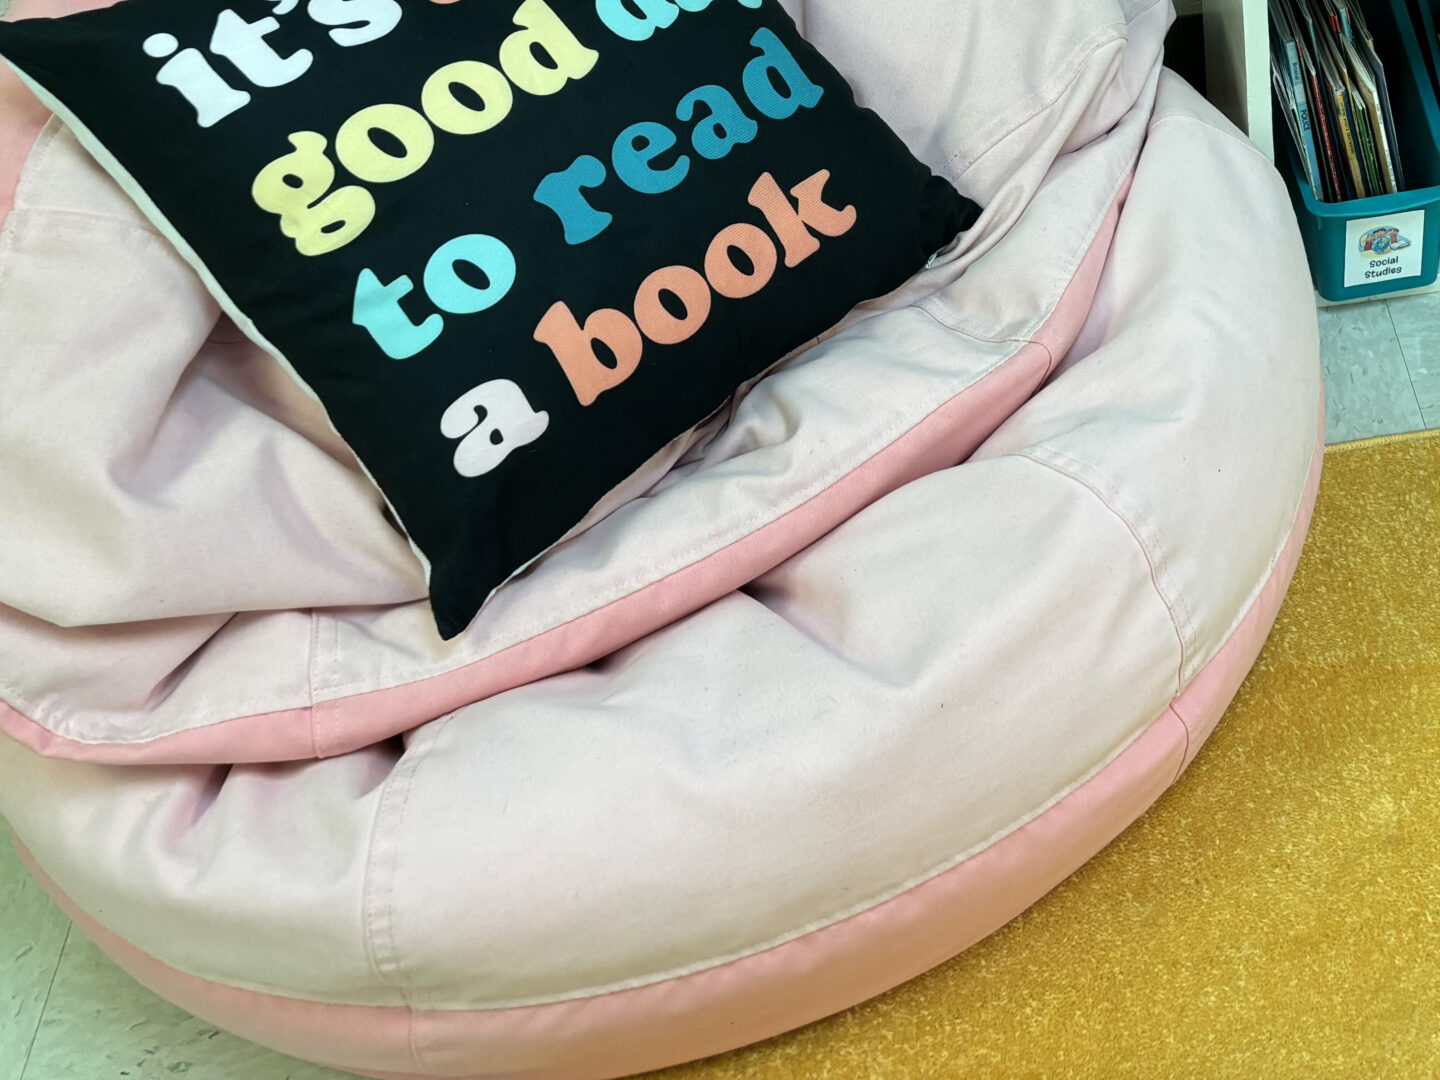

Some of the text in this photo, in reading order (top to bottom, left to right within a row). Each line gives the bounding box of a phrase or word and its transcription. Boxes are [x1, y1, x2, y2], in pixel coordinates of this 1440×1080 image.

[1298, 108, 1310, 131] POLICE
[351, 26, 825, 360] to read
[1364, 266, 1402, 279] Studies
[1369, 256, 1399, 268] Social
[439, 168, 858, 478] a book
